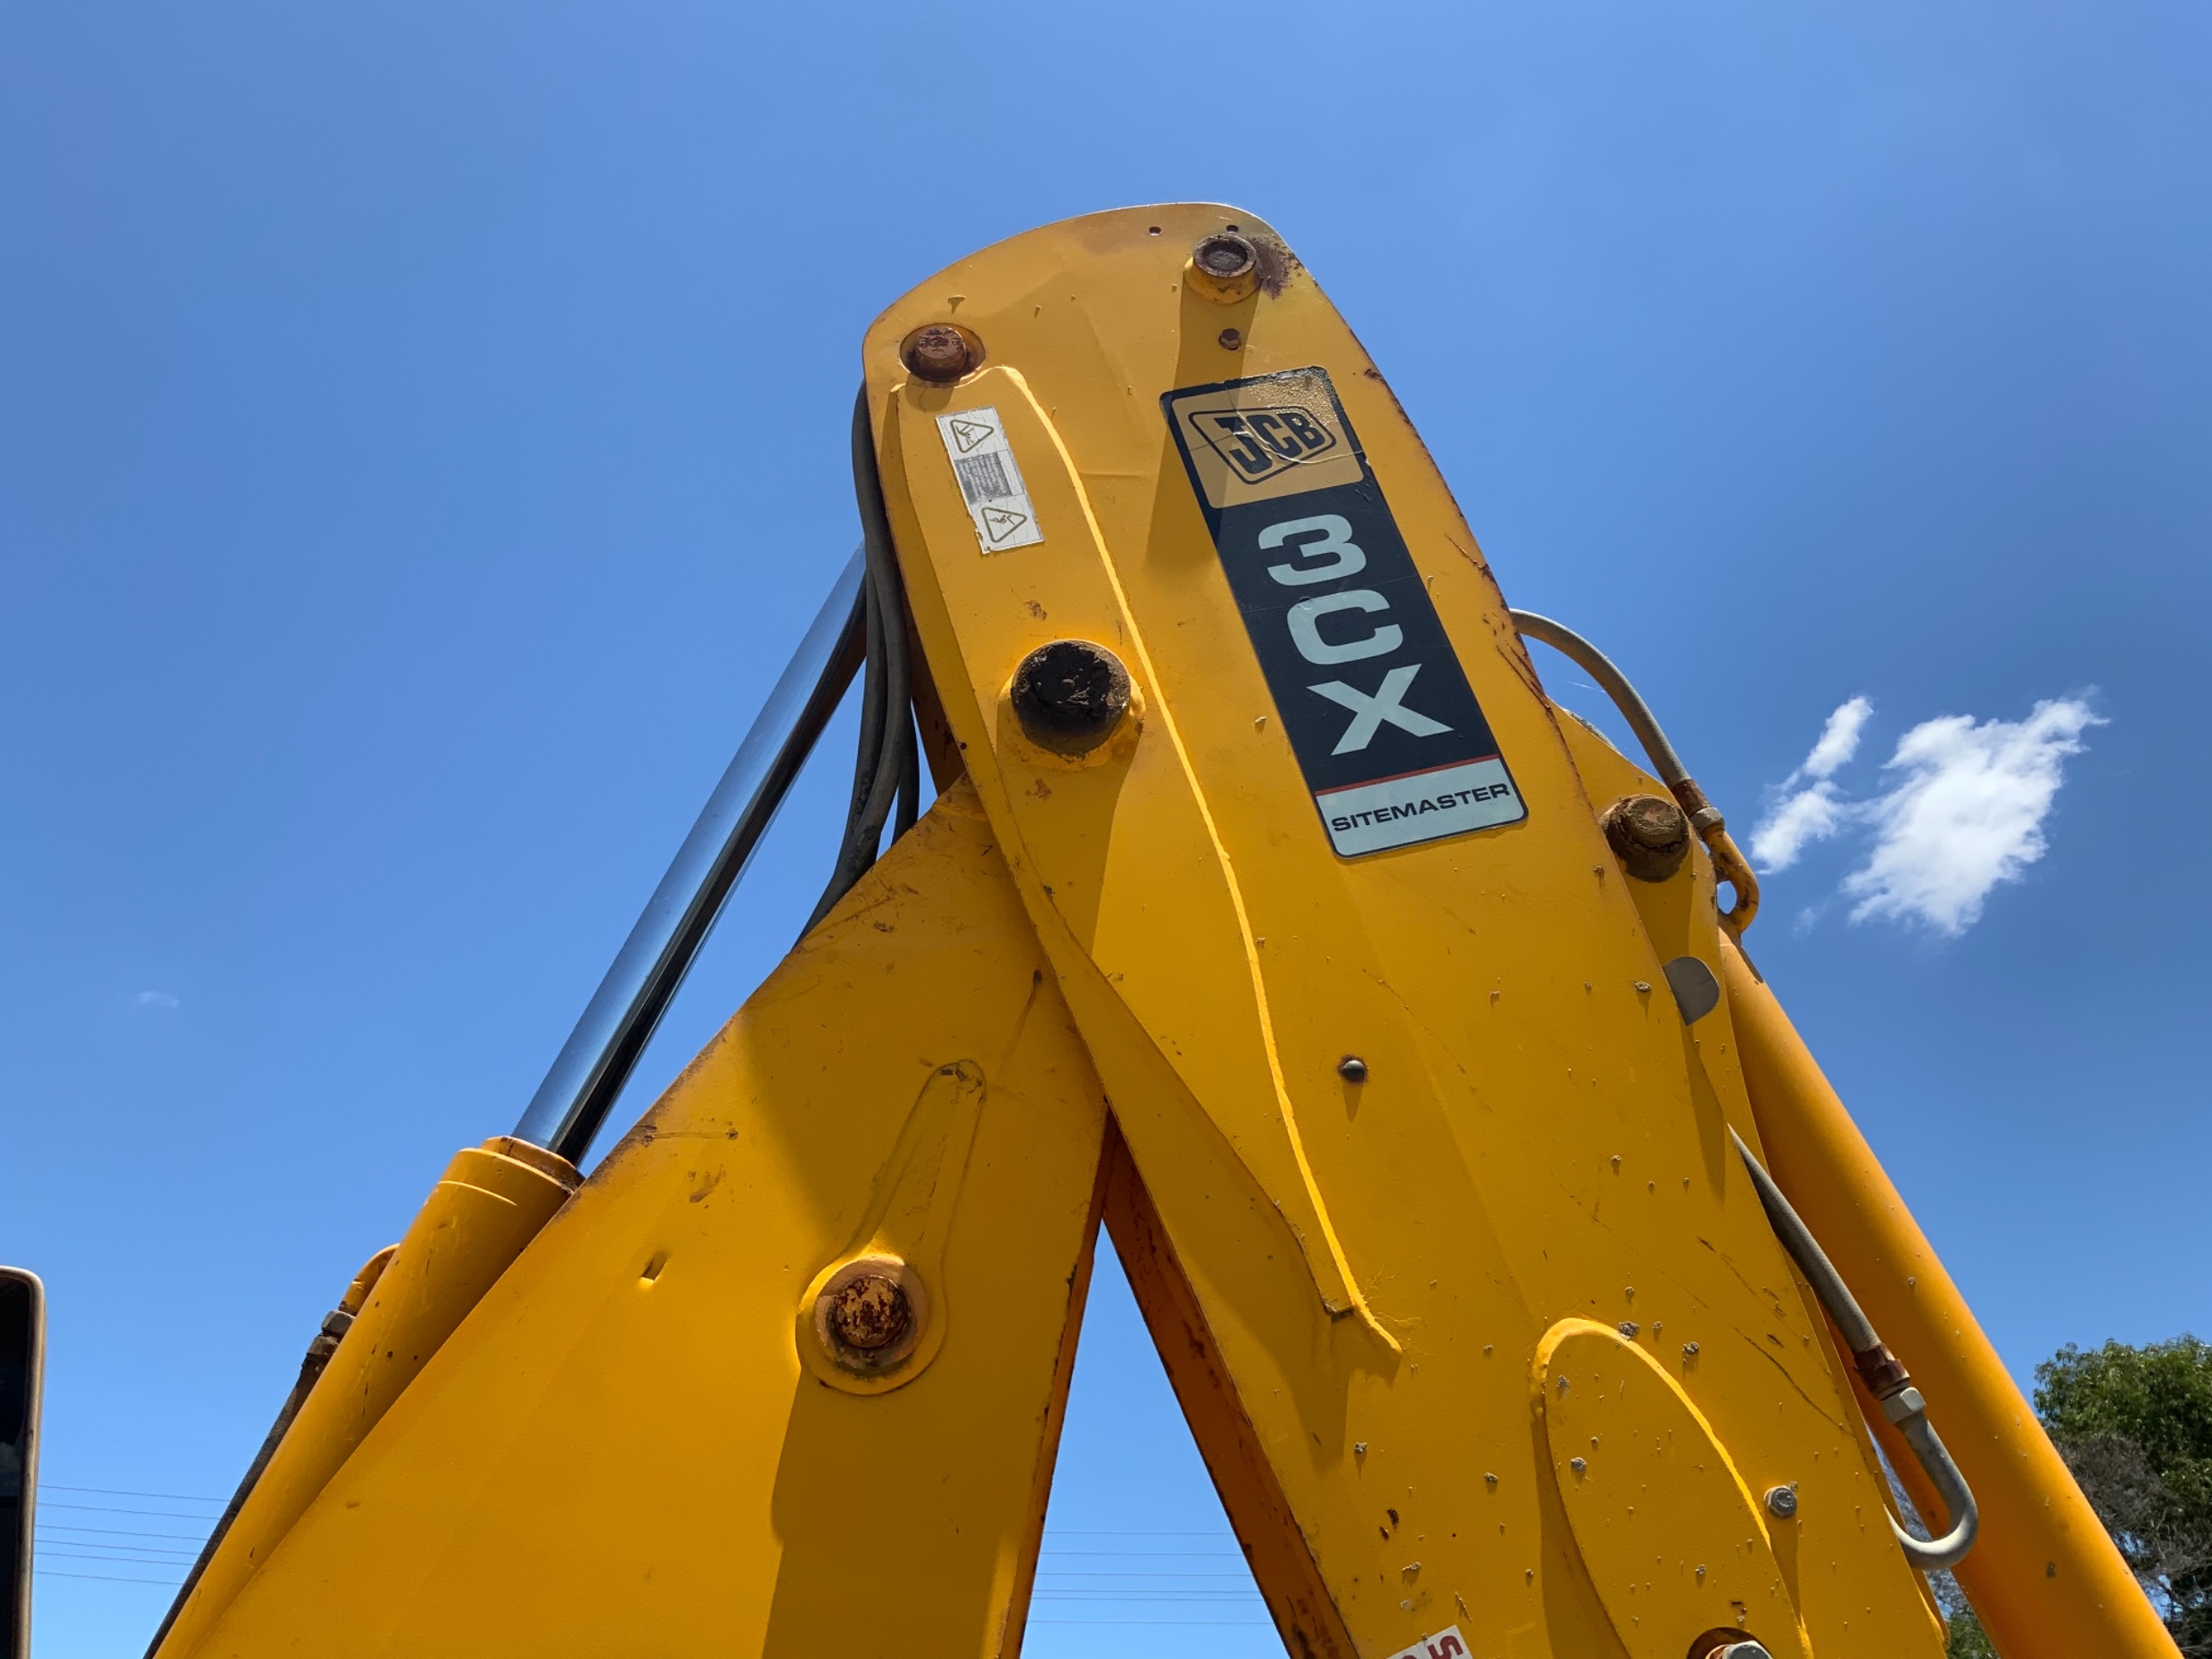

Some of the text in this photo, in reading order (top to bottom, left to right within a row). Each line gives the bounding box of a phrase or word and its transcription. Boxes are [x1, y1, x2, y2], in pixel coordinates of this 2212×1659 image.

[1213, 412, 1326, 475] JCB
[1258, 514, 1456, 756] 3CX
[1332, 782, 1511, 832] SITEMASTER
